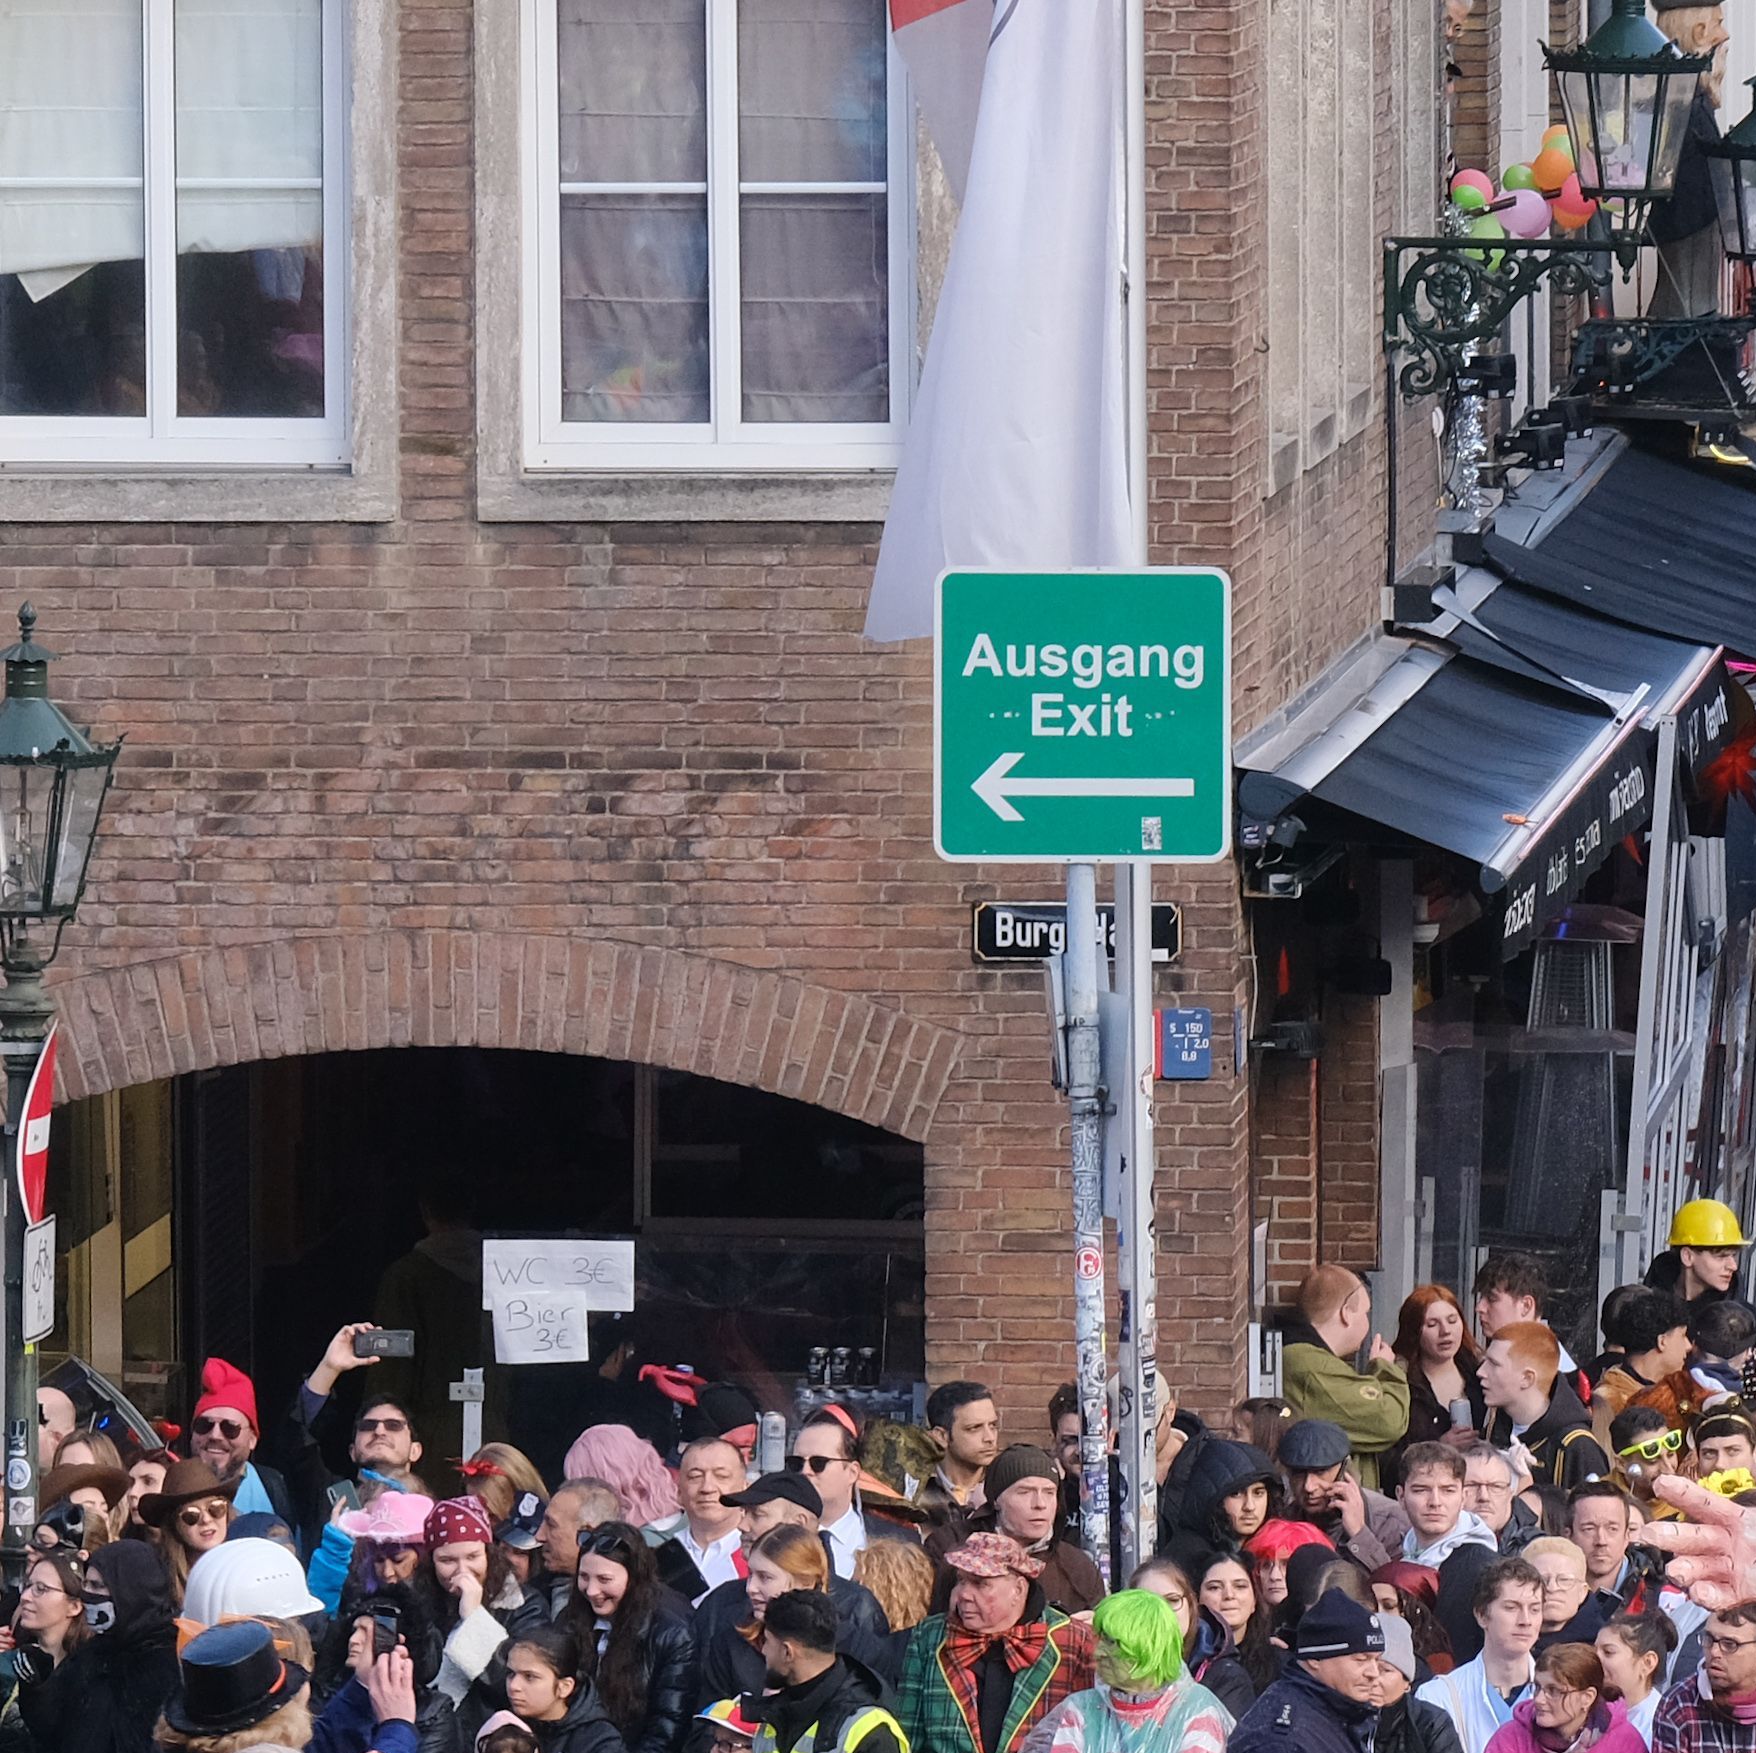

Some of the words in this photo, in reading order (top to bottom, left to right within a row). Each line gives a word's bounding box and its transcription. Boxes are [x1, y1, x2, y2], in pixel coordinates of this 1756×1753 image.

[962, 633, 1204, 689] Ausgang
[1031, 693, 1133, 736] Exit
[493, 1257, 549, 1285] WC
[571, 1257, 616, 1286] 3€
[505, 1300, 575, 1332] Bier
[533, 1327, 574, 1354] 3€
